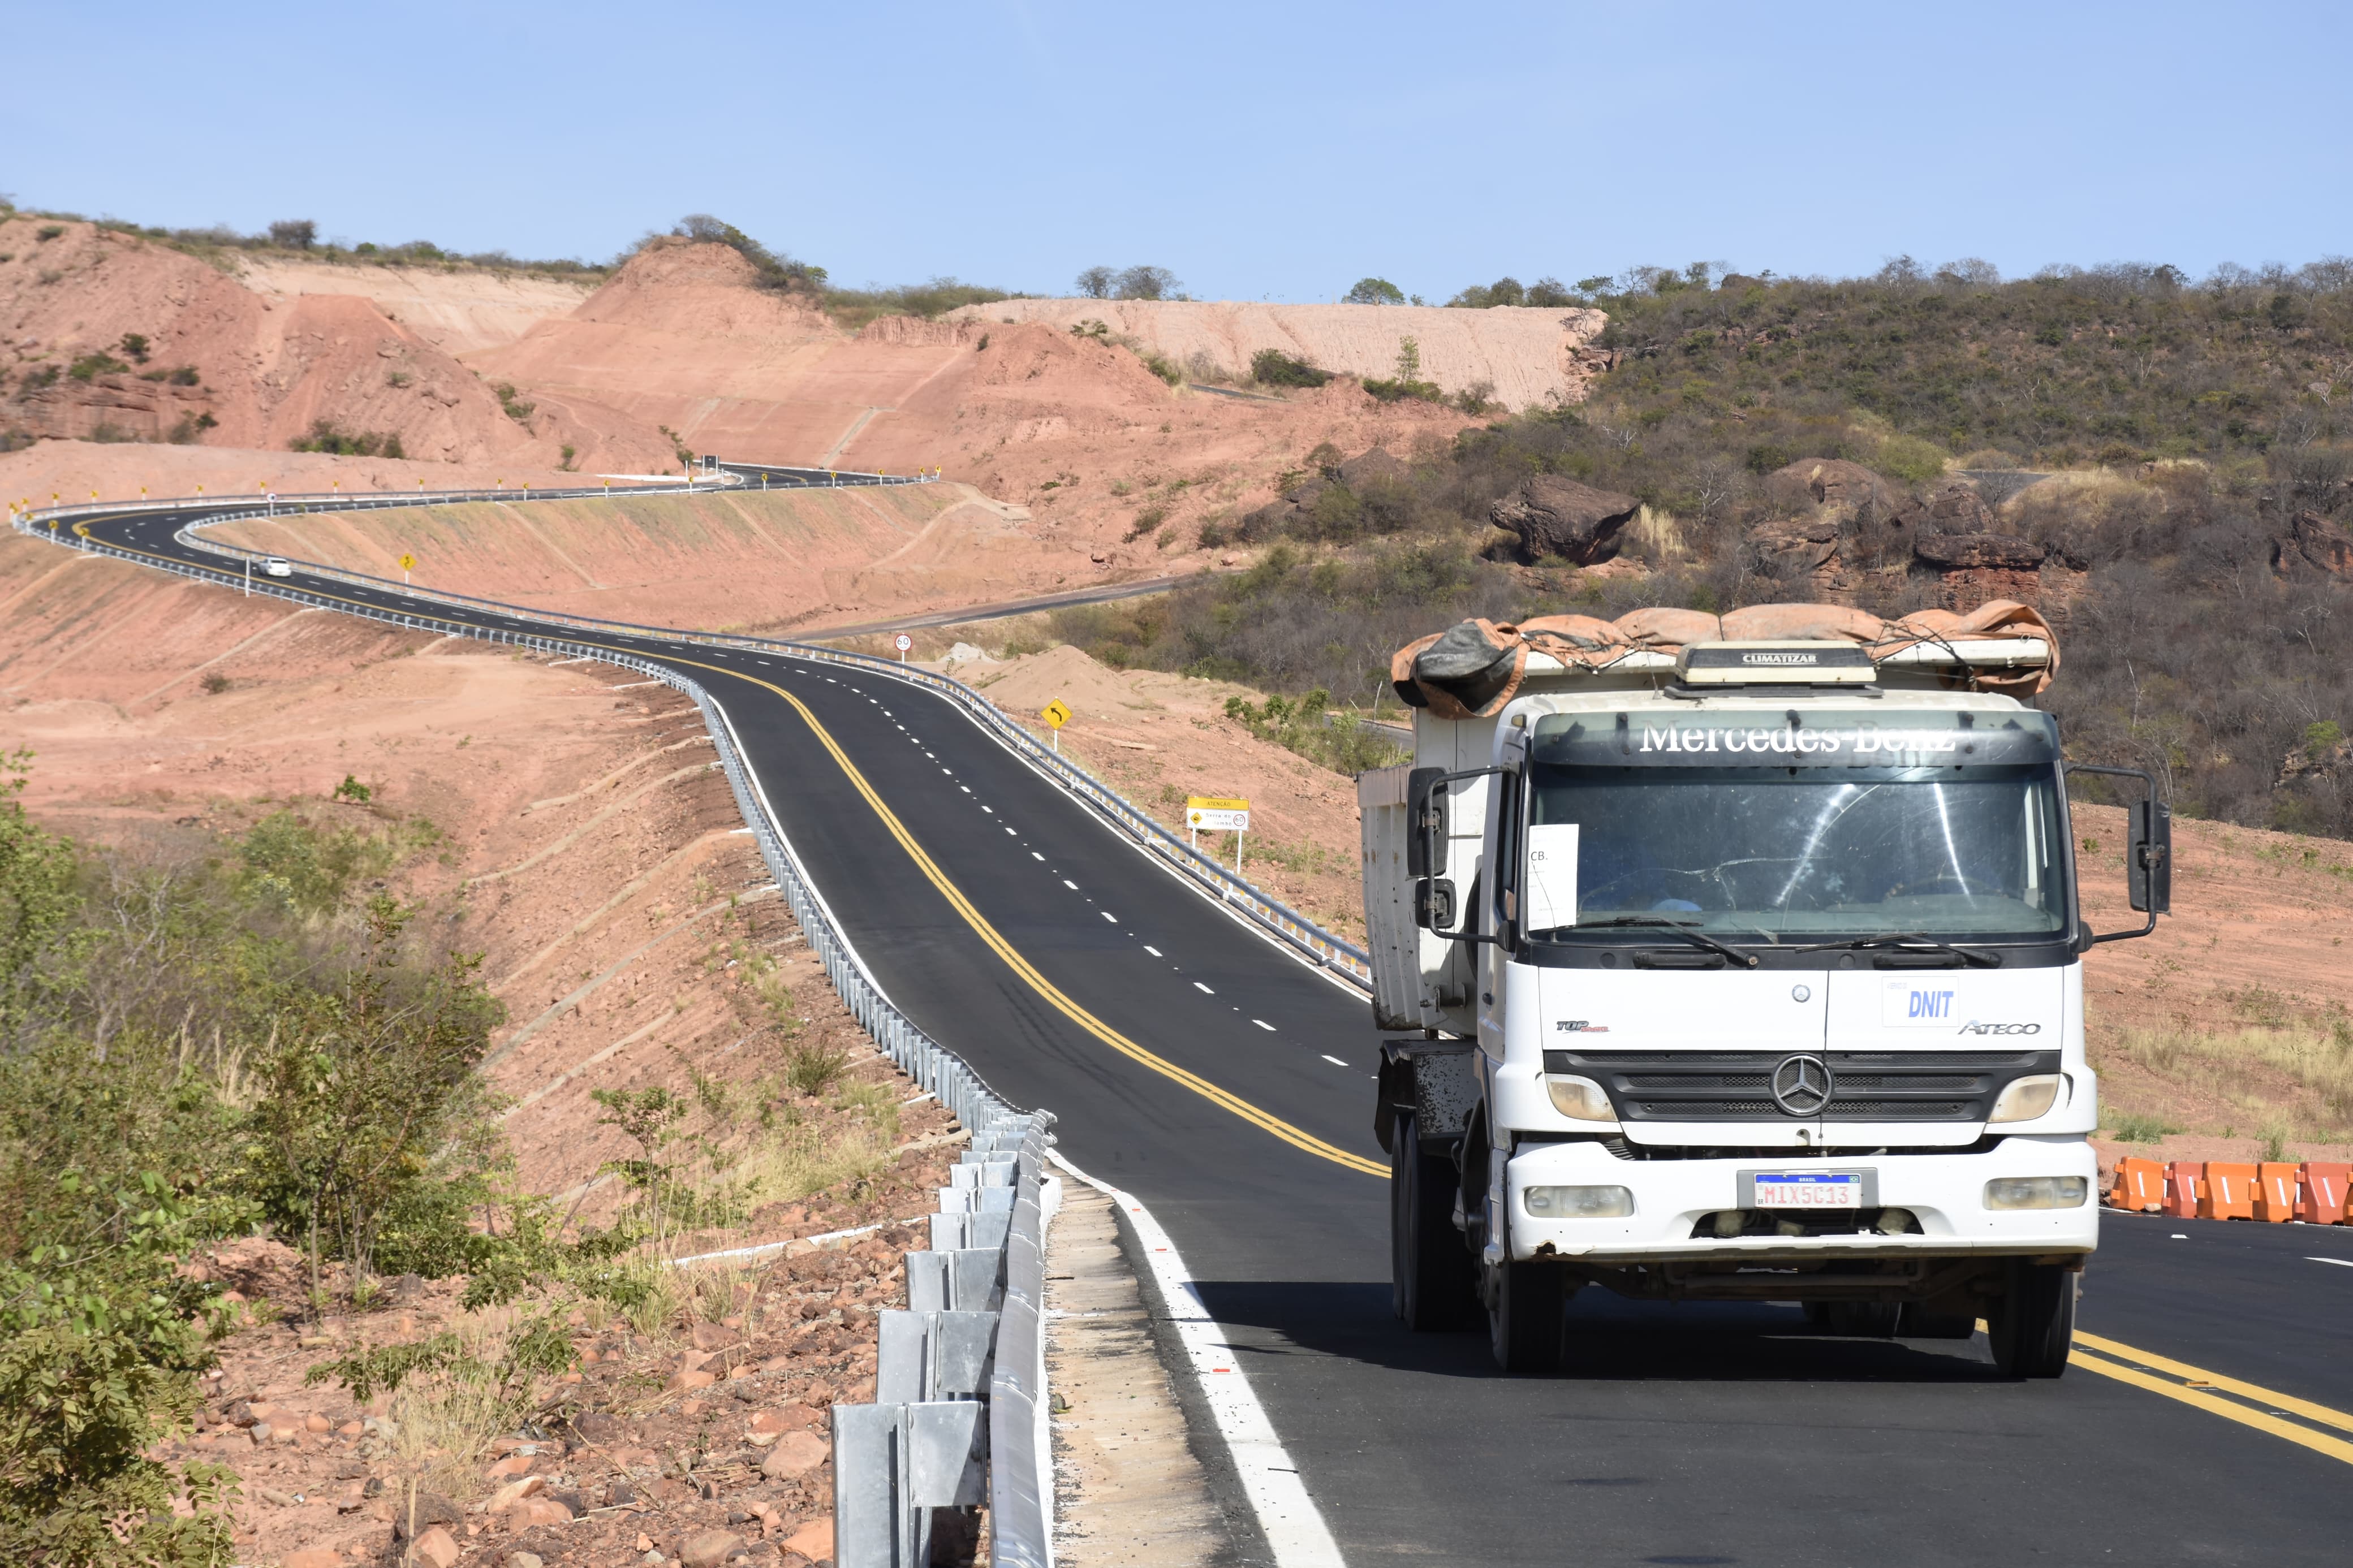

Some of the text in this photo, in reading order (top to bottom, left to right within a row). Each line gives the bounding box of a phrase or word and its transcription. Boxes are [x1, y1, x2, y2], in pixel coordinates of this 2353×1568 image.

[1742, 655, 1817, 663] CLIMATIZAR
[1639, 719, 1955, 753] Mercedes-Benz
[1908, 991, 1954, 1018] DNIT
[1557, 1020, 1589, 1031] TOP
[1764, 1185, 1849, 1204] MIX5C13
